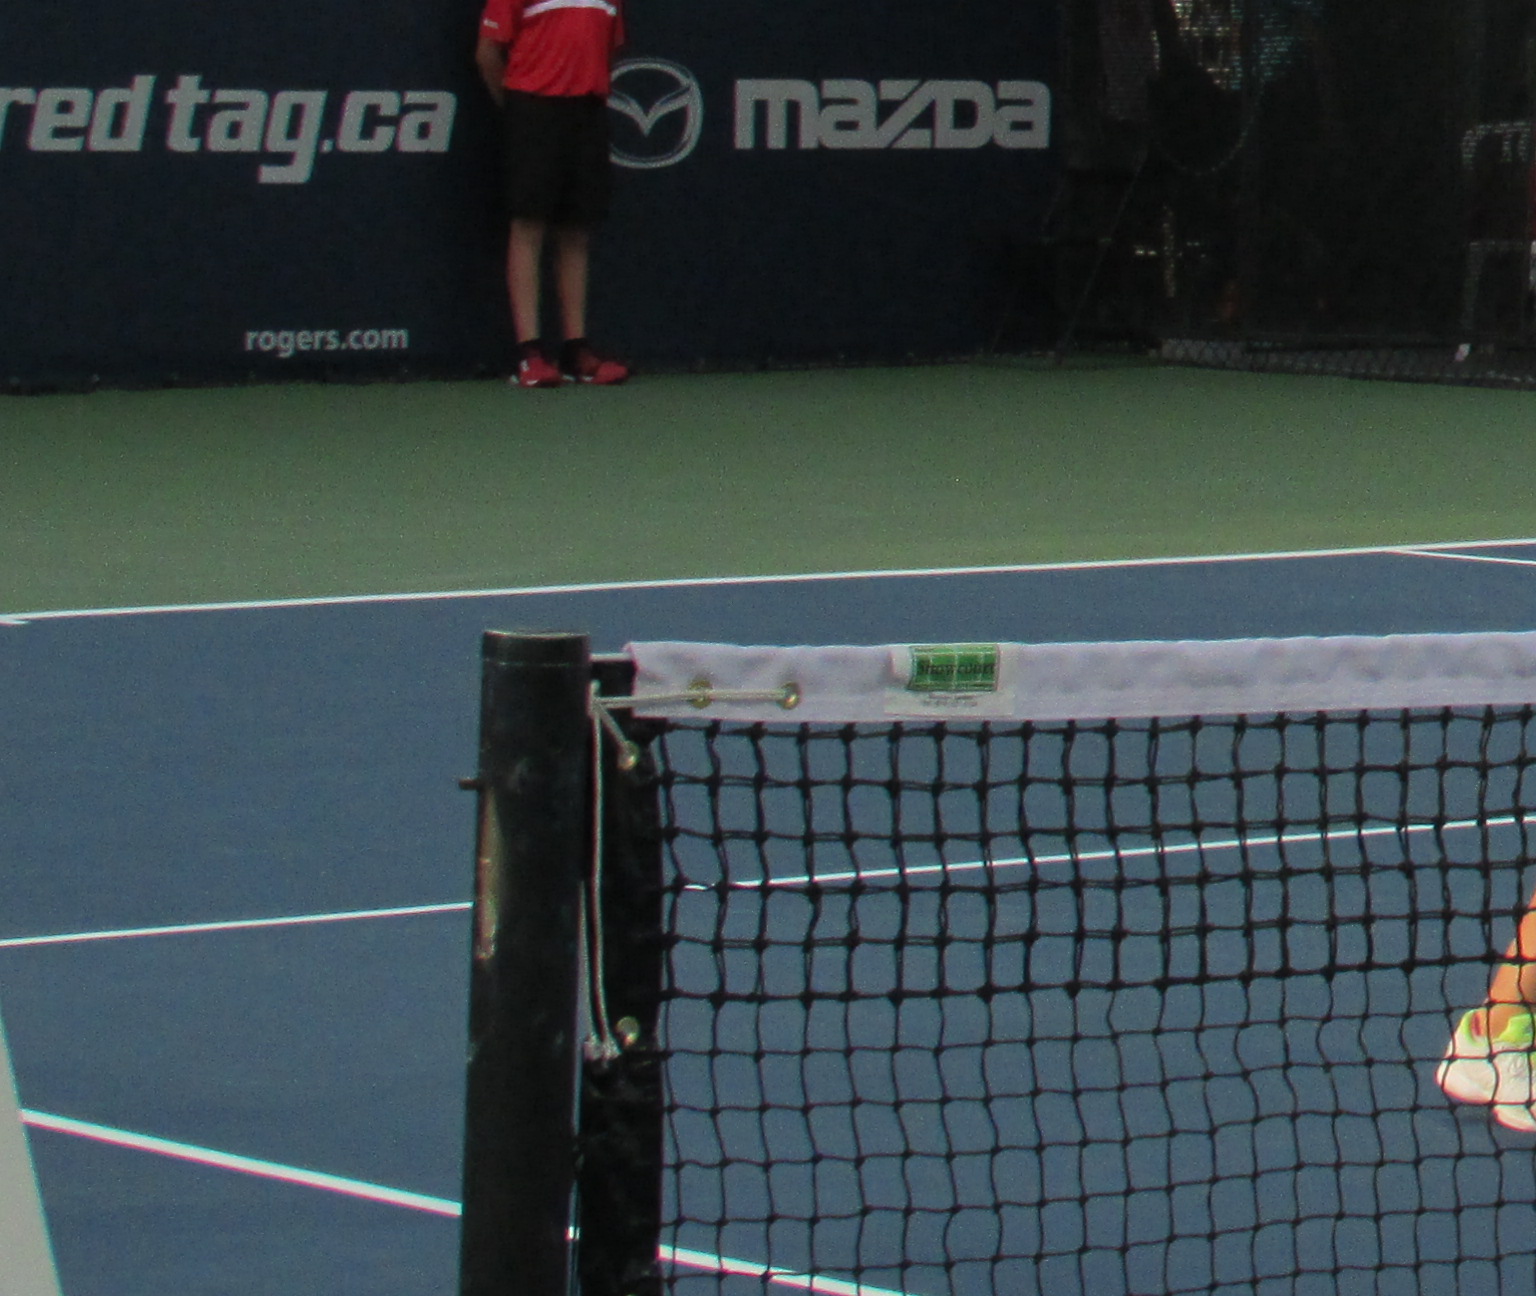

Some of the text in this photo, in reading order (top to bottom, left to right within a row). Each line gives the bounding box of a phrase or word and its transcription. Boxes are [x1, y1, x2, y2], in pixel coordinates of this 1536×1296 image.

[0, 74, 458, 184] red tag.ca
[245, 328, 409, 359] rogers.com
